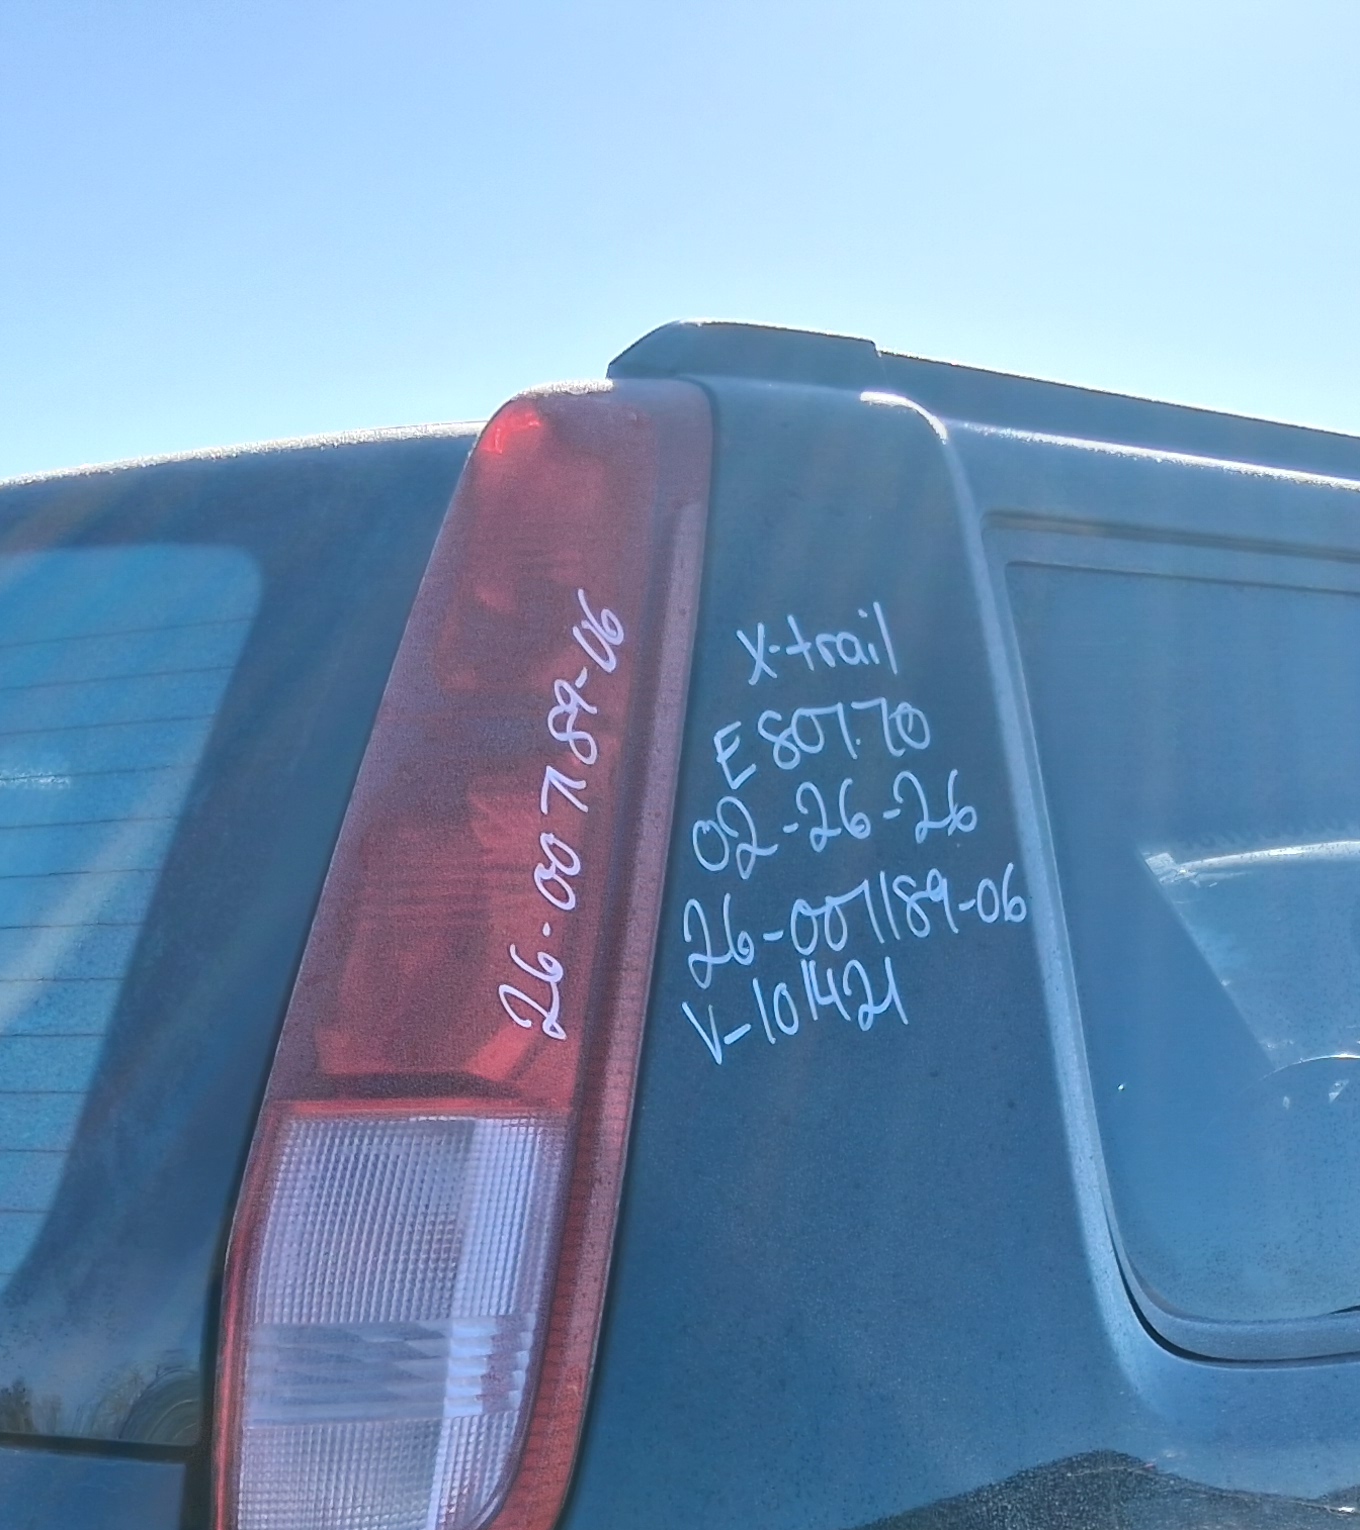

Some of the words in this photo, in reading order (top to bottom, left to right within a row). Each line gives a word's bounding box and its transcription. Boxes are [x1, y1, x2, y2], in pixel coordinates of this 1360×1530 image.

[736, 601, 897, 685] X-trail
[692, 770, 978, 879] 02-26-26
[683, 863, 1028, 990] 26-007189-06
[681, 956, 909, 1065] V-101421
